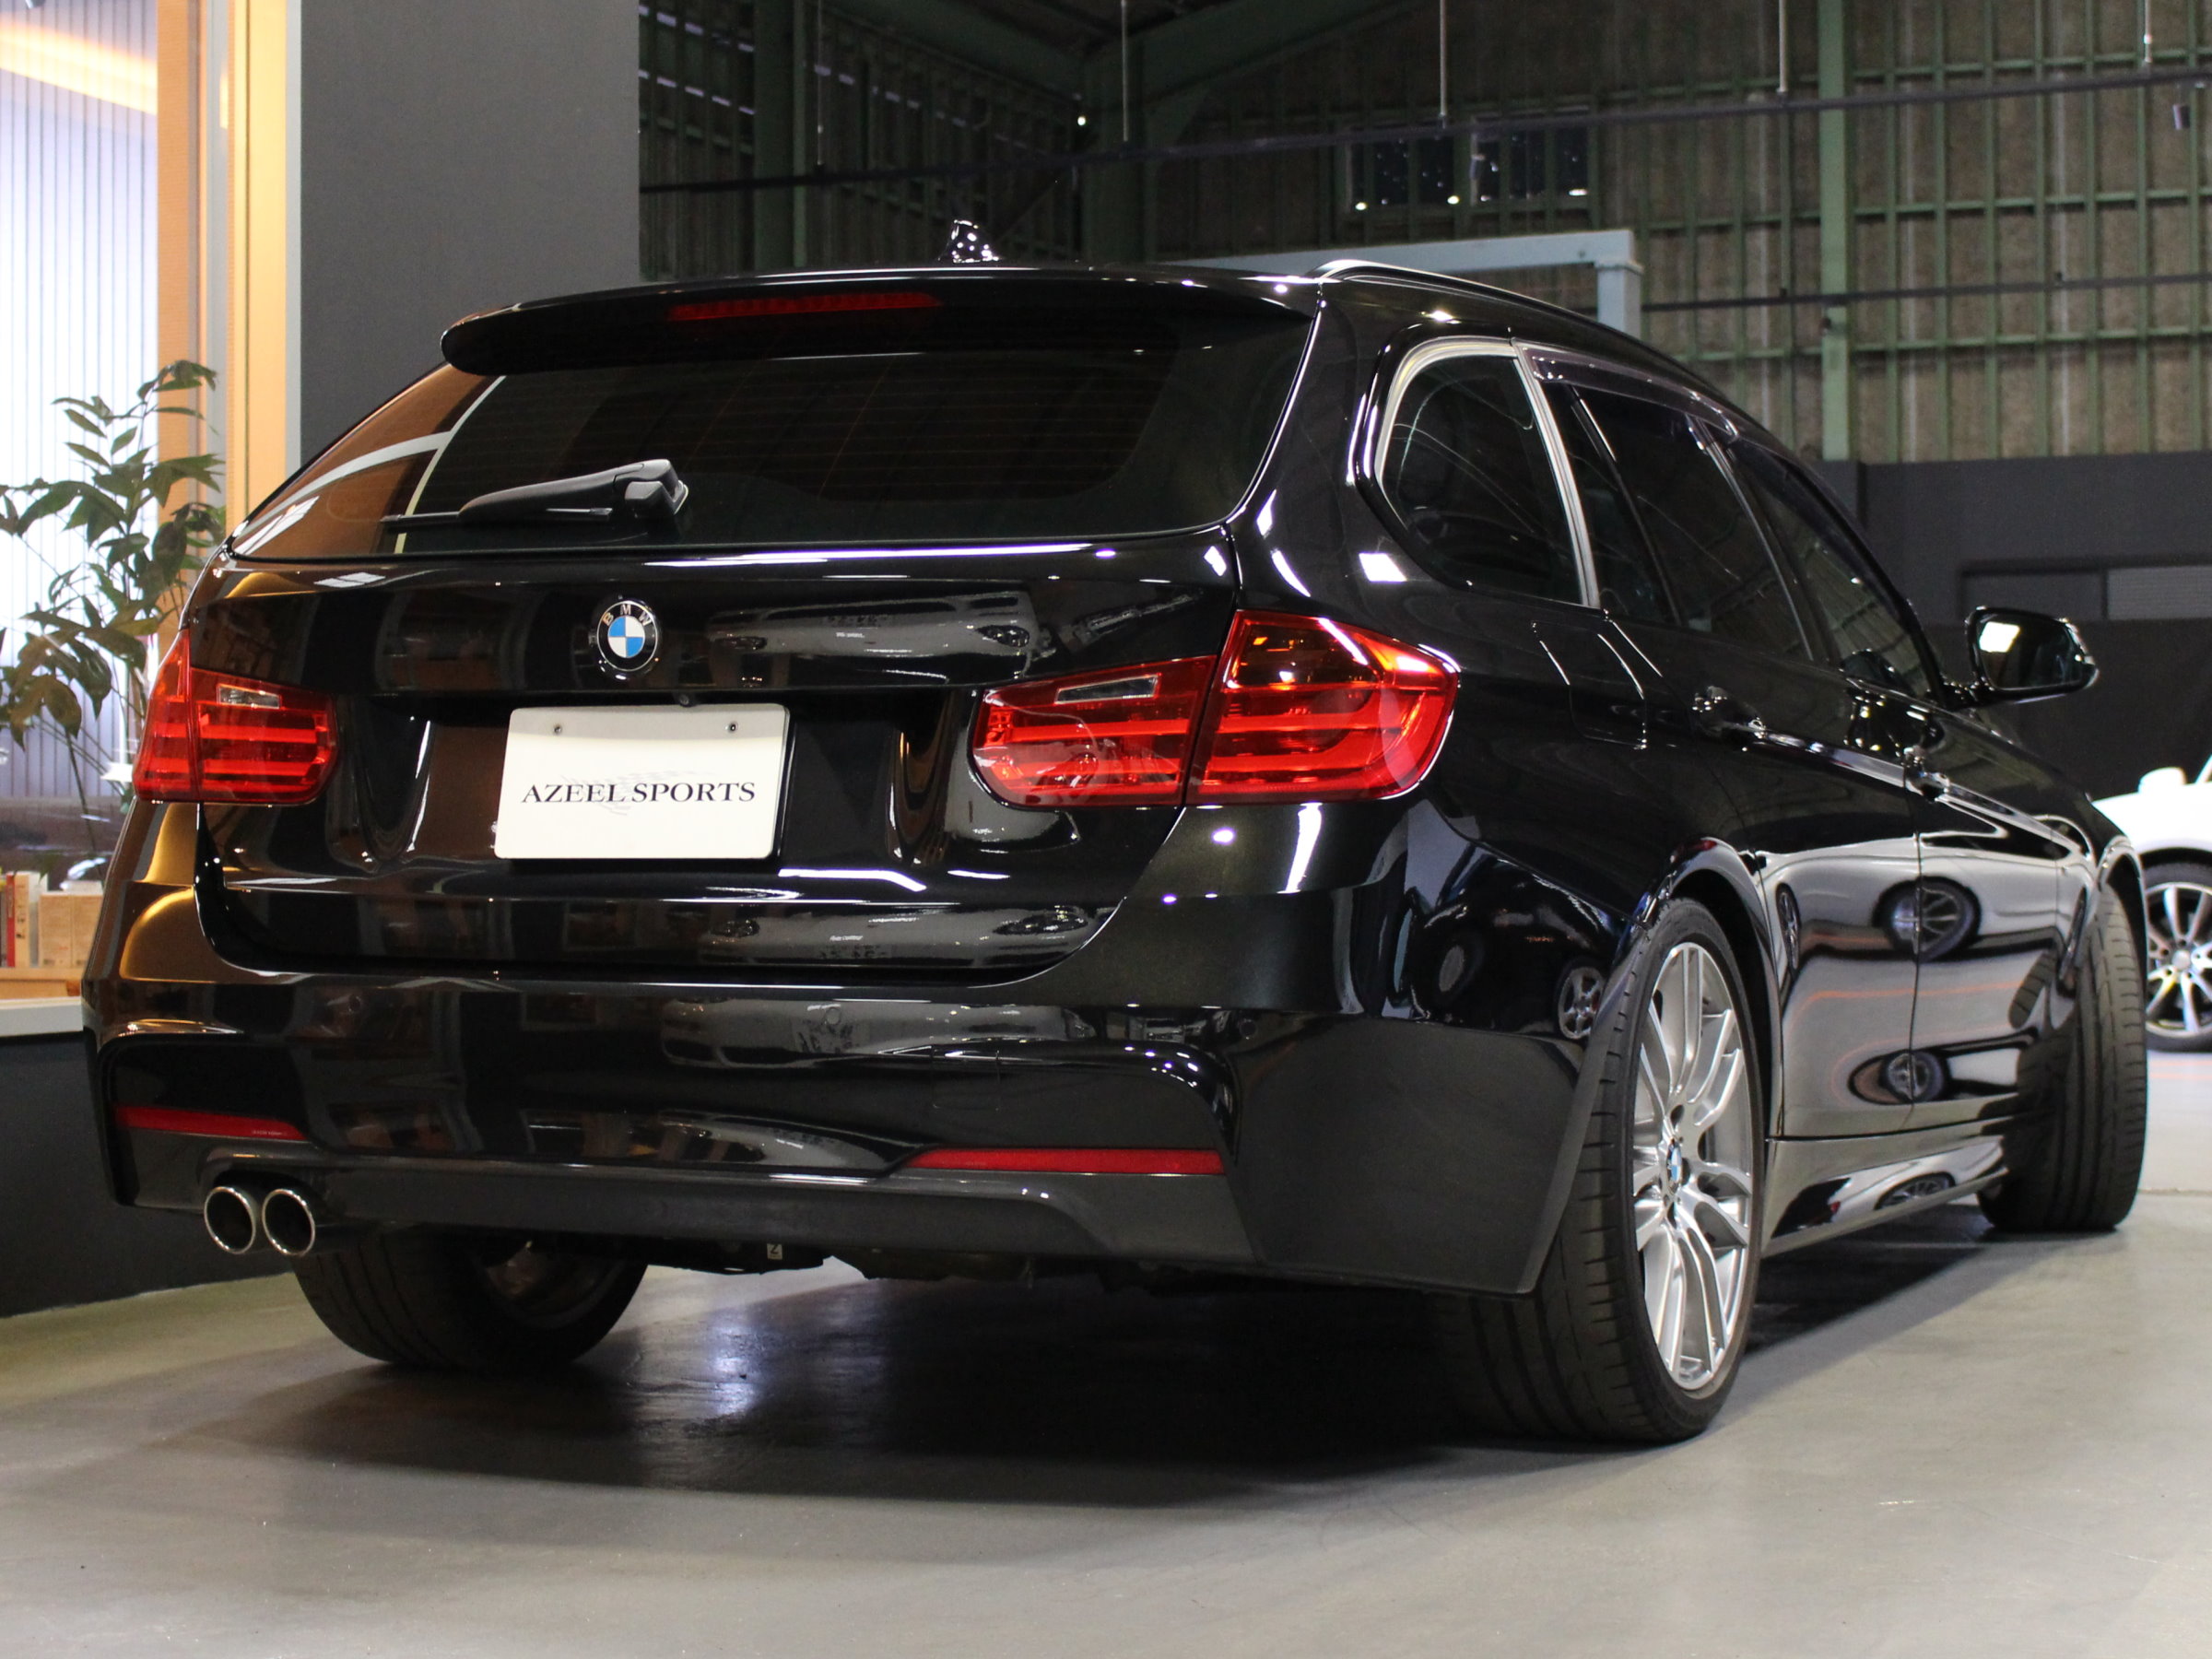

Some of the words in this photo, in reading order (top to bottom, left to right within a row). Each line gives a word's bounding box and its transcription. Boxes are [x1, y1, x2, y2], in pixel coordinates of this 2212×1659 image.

[602, 604, 653, 627] BMW
[522, 783, 627, 804] AZEEL
[631, 782, 756, 803] SPORTS
